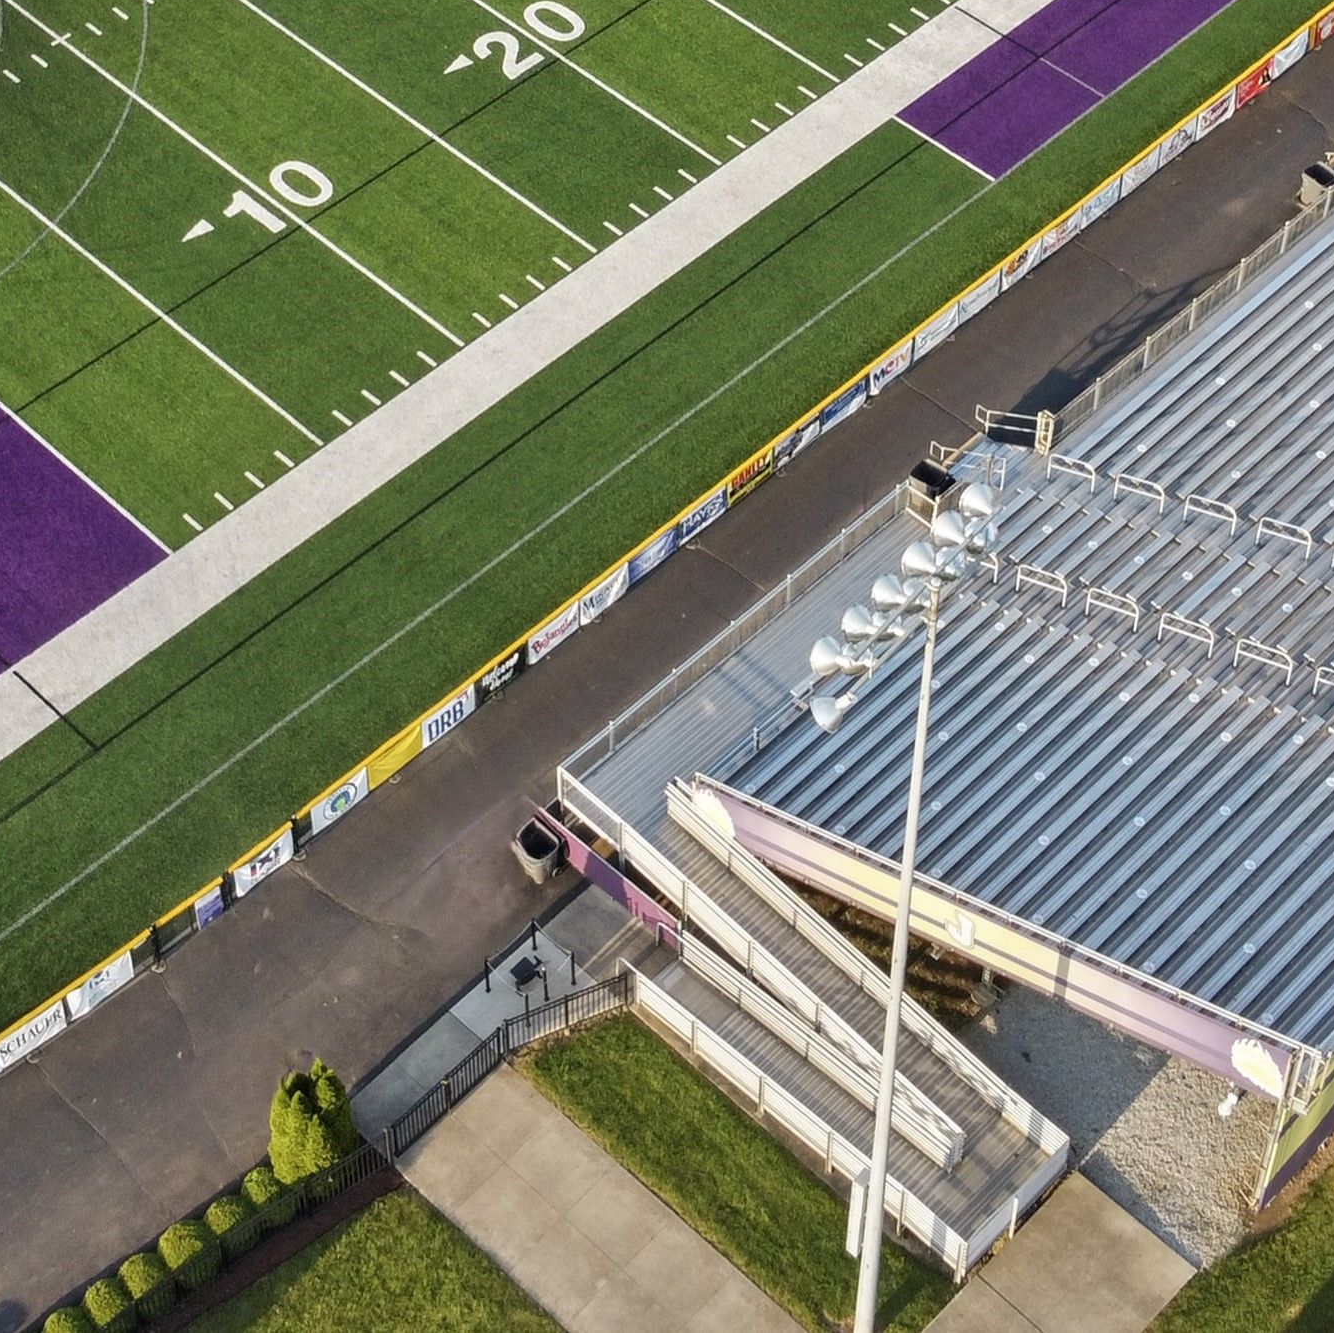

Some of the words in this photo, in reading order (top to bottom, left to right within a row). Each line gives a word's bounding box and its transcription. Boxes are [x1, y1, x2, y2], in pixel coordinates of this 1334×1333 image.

[473, 0, 586, 80] 20
[223, 160, 334, 233] 10
[427, 700, 465, 743] DRB
